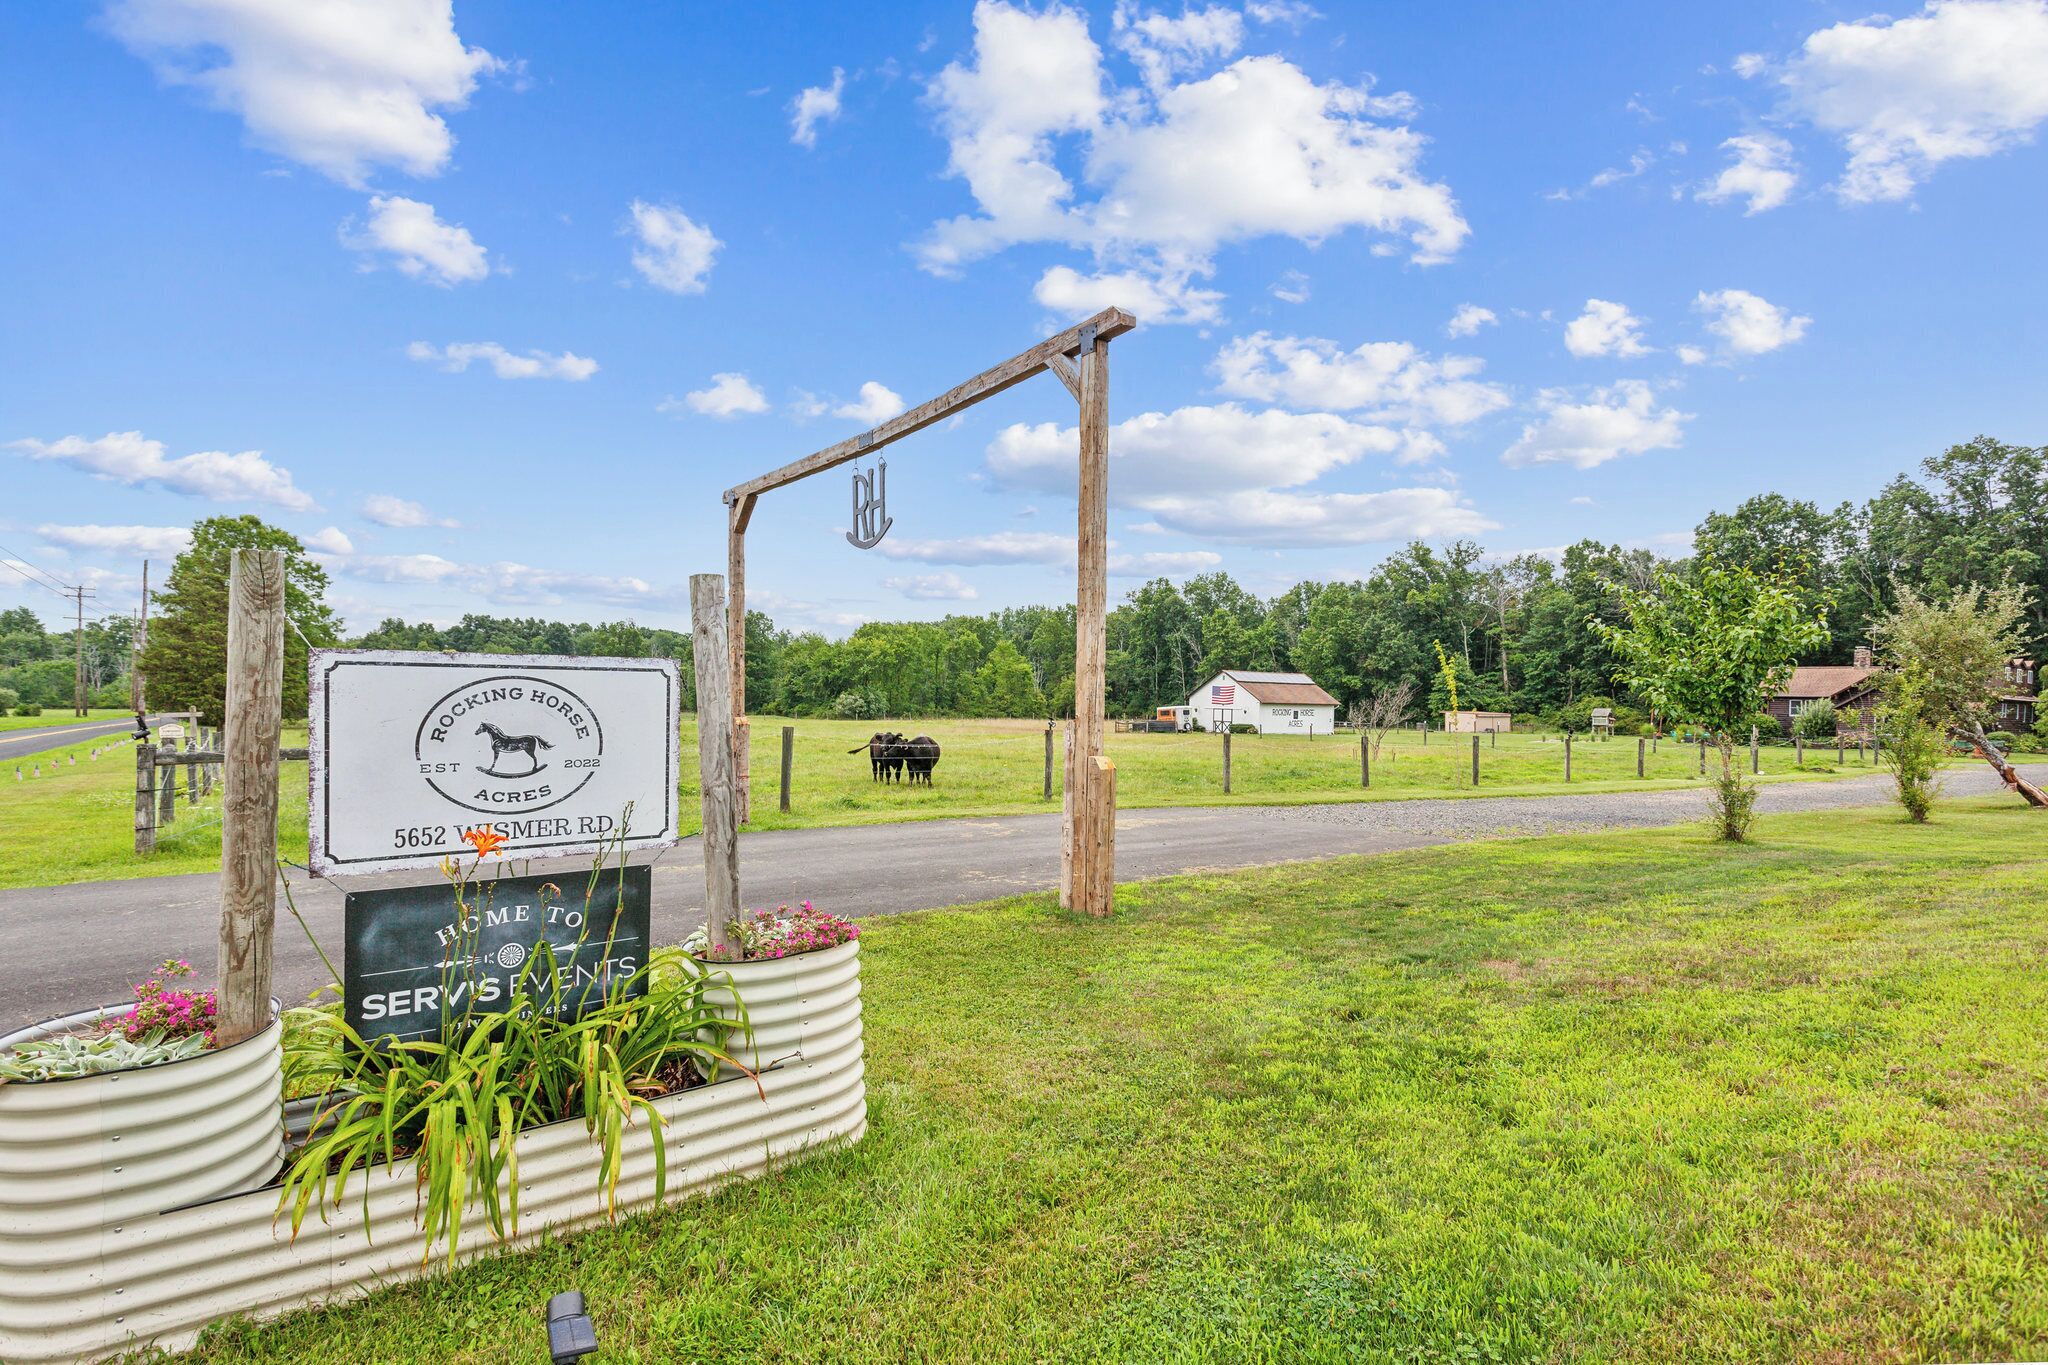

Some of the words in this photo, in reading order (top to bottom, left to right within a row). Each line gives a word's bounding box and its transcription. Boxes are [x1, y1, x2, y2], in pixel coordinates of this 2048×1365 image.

[852, 462, 886, 542] RH
[430, 686, 523, 743] ROCKING
[530, 688, 591, 740] HORSE
[1271, 708, 1292, 716] ROCKING
[1300, 708, 1315, 716] HORSE
[1288, 719, 1304, 728] ACRES
[419, 763, 460, 774] EST
[564, 758, 601, 768] 2022
[473, 784, 552, 803] ACRES
[394, 826, 446, 848] 5652
[453, 818, 572, 844] WSMER
[577, 815, 614, 834] RD
[434, 905, 530, 947] HOME
[547, 906, 583, 928] TO
